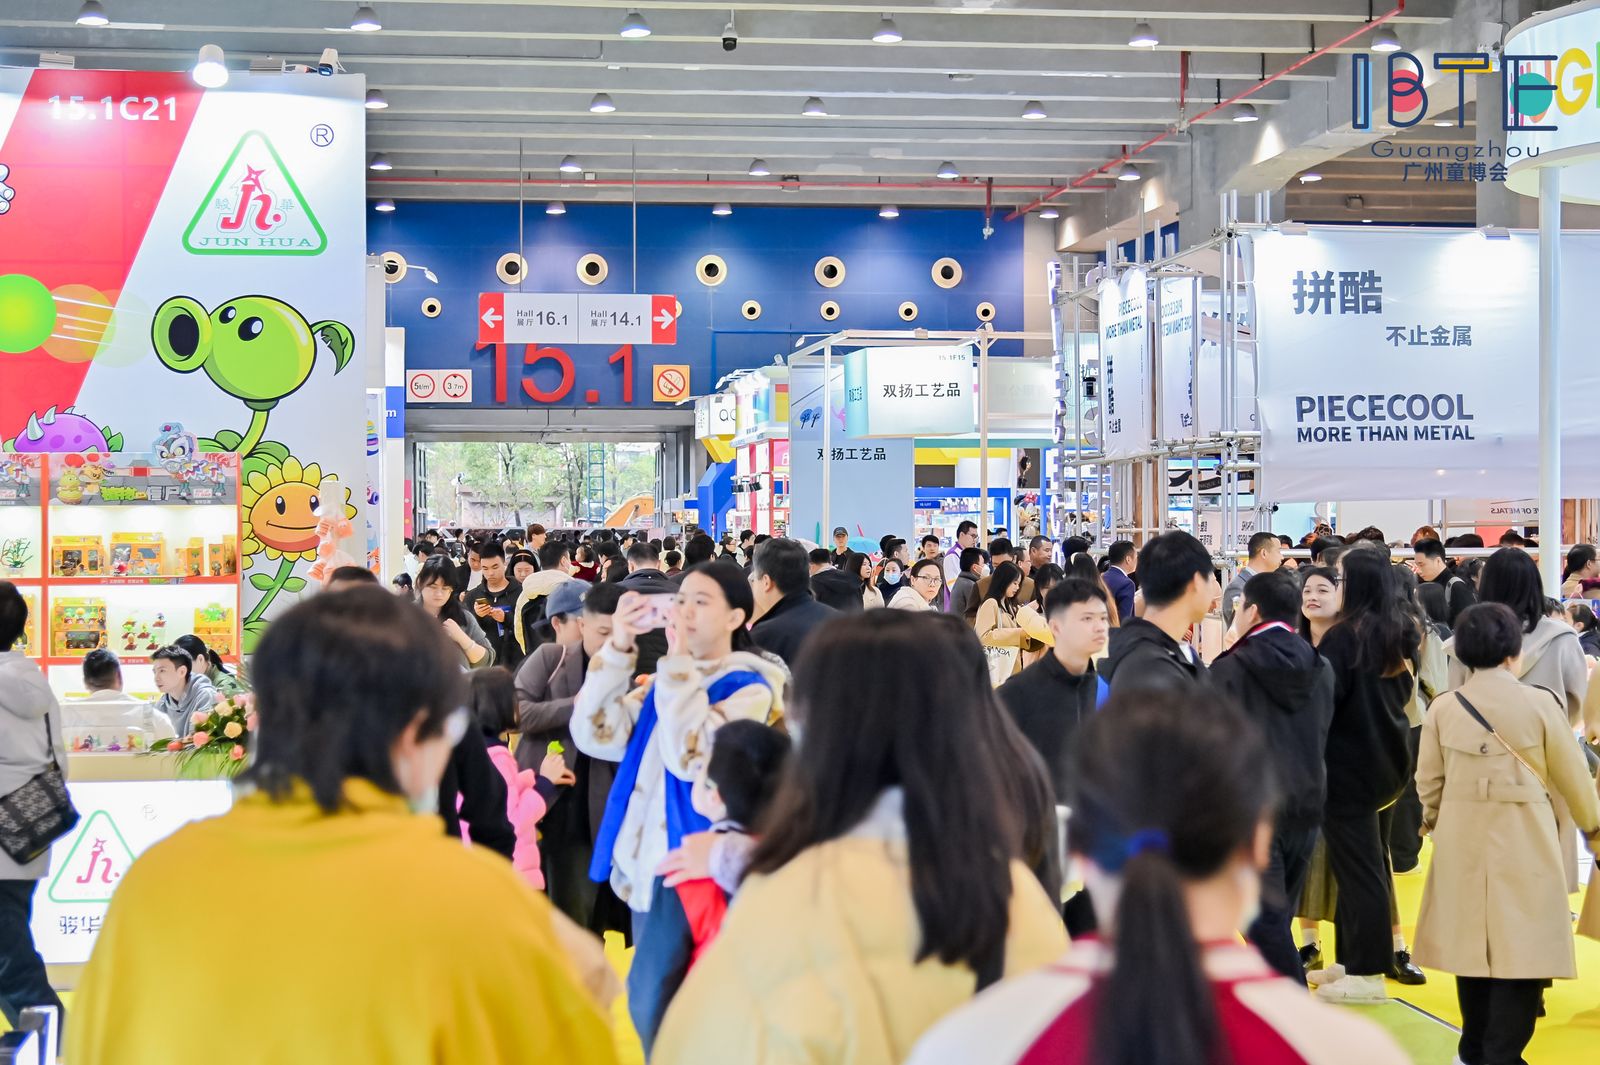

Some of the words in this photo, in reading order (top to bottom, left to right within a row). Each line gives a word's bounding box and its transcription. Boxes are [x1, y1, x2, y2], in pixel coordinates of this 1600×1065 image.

[48, 95, 176, 121] 15.1C21
[198, 237, 250, 247] JUN
[257, 237, 314, 248] HUA
[1292, 269, 1383, 315] 拼酷
[516, 309, 534, 317] Hall
[536, 311, 568, 326] 16.1
[590, 310, 608, 318] Hall
[610, 311, 641, 326] 14.1
[516, 318, 534, 327] 展厅
[590, 319, 607, 327] 展厅
[1386, 325, 1472, 347] 不止金属
[475, 343, 633, 403] 15.1
[883, 382, 961, 398] 双扬工艺品
[1295, 393, 1474, 423] PIECECOOL
[1296, 426, 1352, 443] MORE
[1356, 425, 1409, 442] THAN
[1413, 424, 1475, 441] METAL
